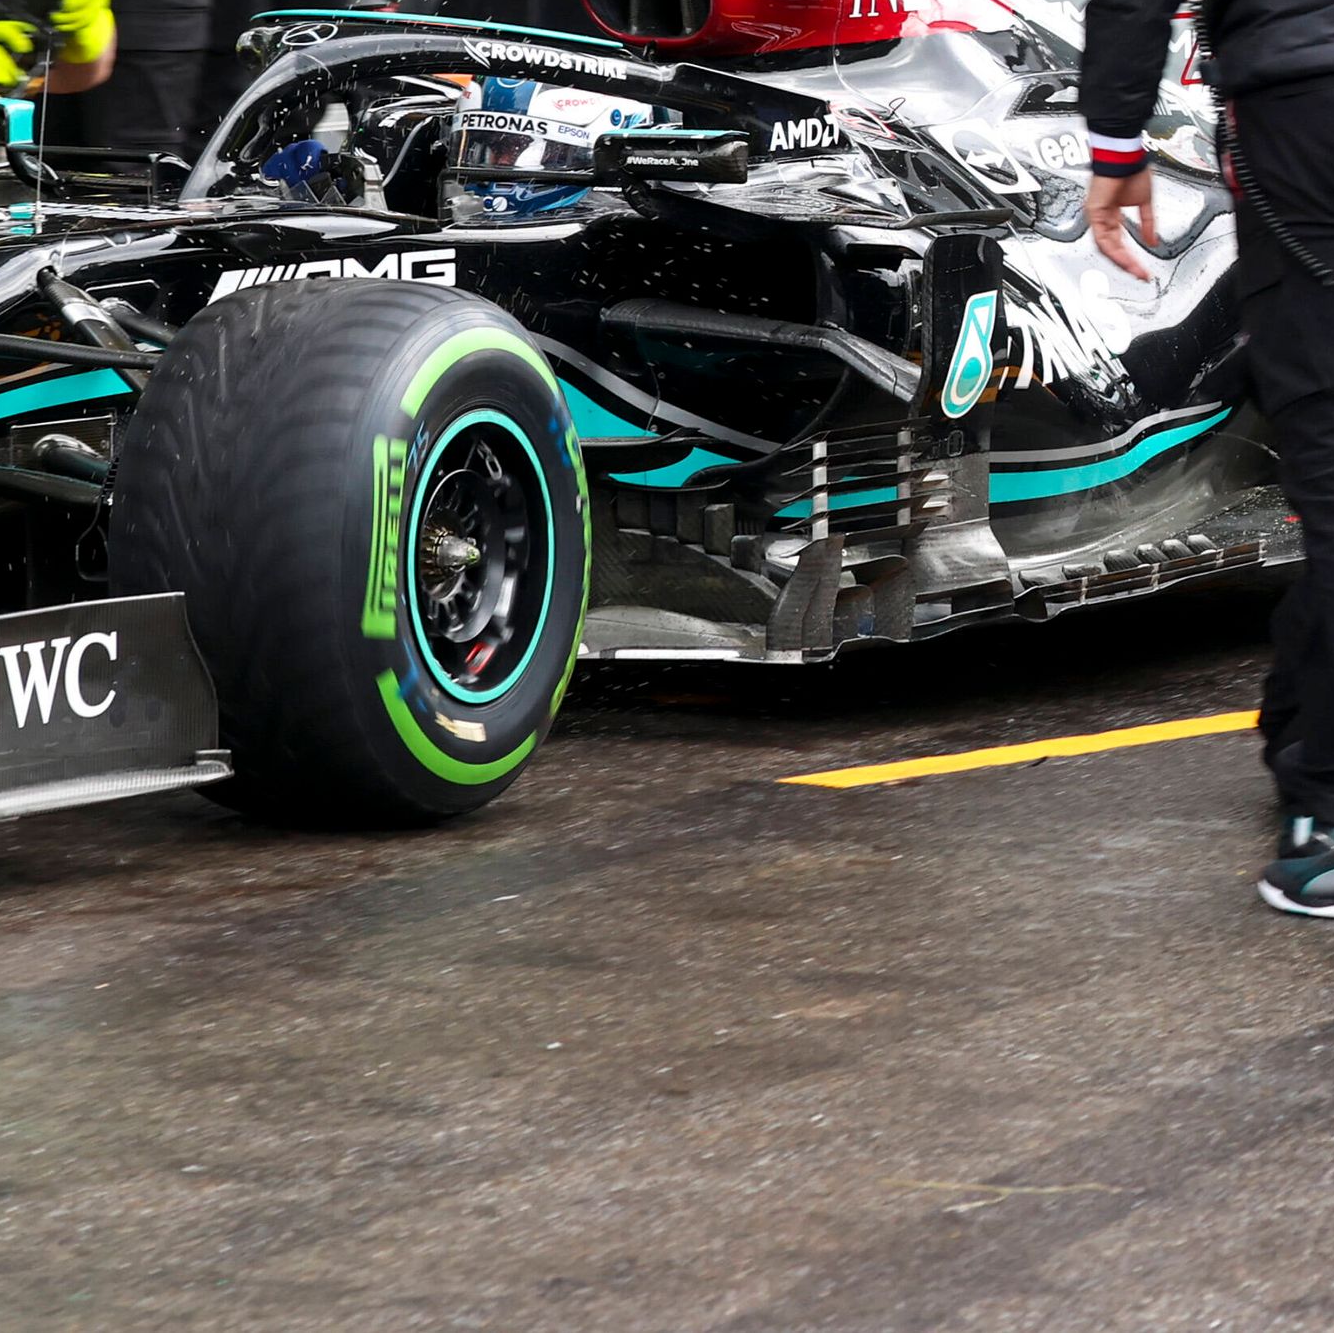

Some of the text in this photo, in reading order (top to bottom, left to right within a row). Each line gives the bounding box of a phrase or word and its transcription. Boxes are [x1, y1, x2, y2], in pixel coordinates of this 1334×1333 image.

[475, 41, 628, 81] CROWDSTRIKE
[461, 113, 591, 140] PETRONAS EPSON
[770, 117, 823, 152] AMD
[360, 433, 408, 640] PIRELLI
